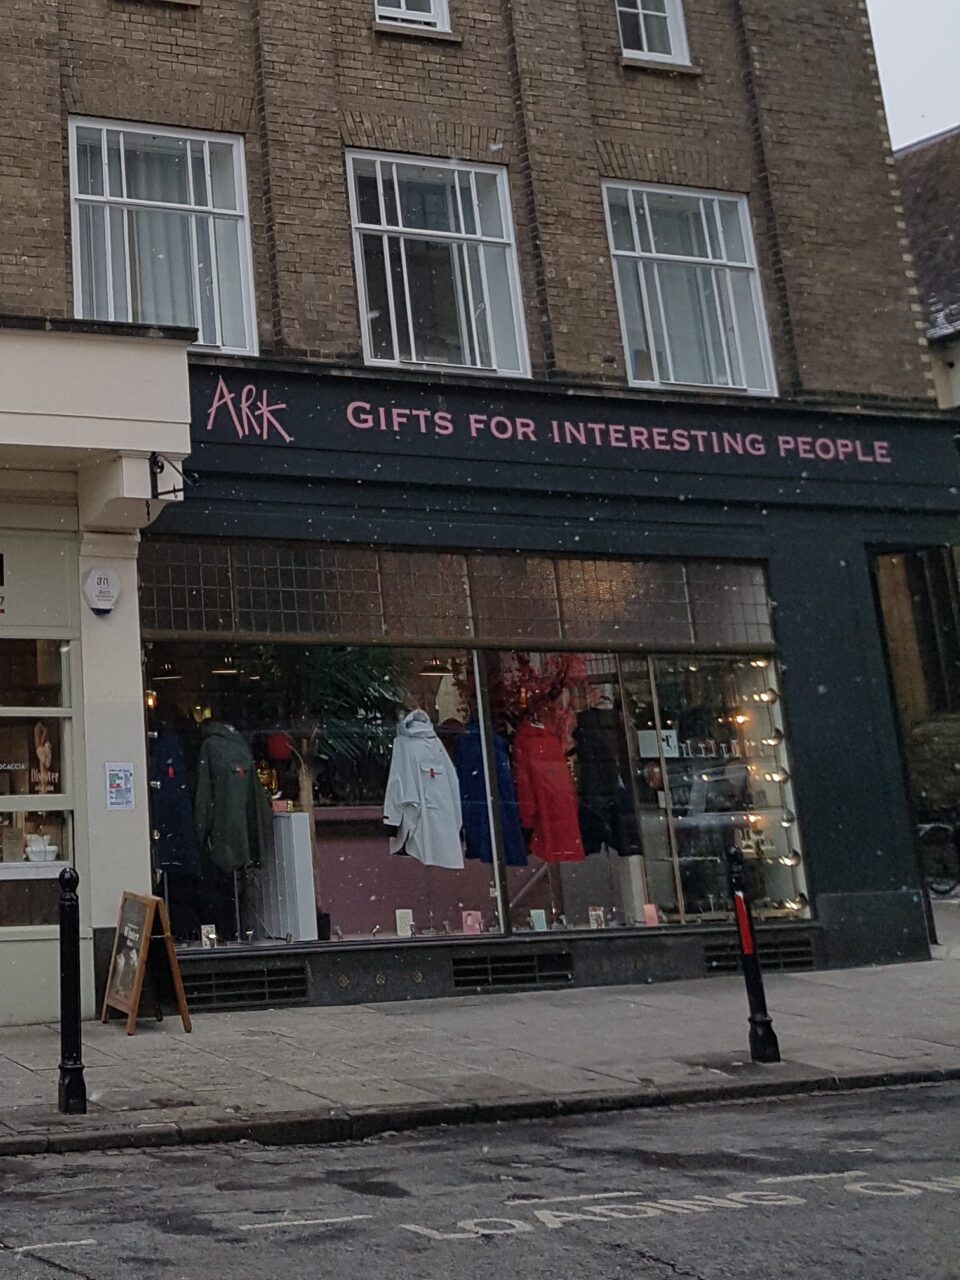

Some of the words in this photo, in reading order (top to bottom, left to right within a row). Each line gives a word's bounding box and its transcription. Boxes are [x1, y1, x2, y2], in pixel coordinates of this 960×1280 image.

[207, 376, 291, 443] ARK
[346, 401, 454, 435] GIFTS
[469, 414, 537, 442] FOR
[551, 420, 767, 456] INTERESTING
[777, 435, 892, 463] PEOPLE
[400, 1191, 806, 1239] LOADING
